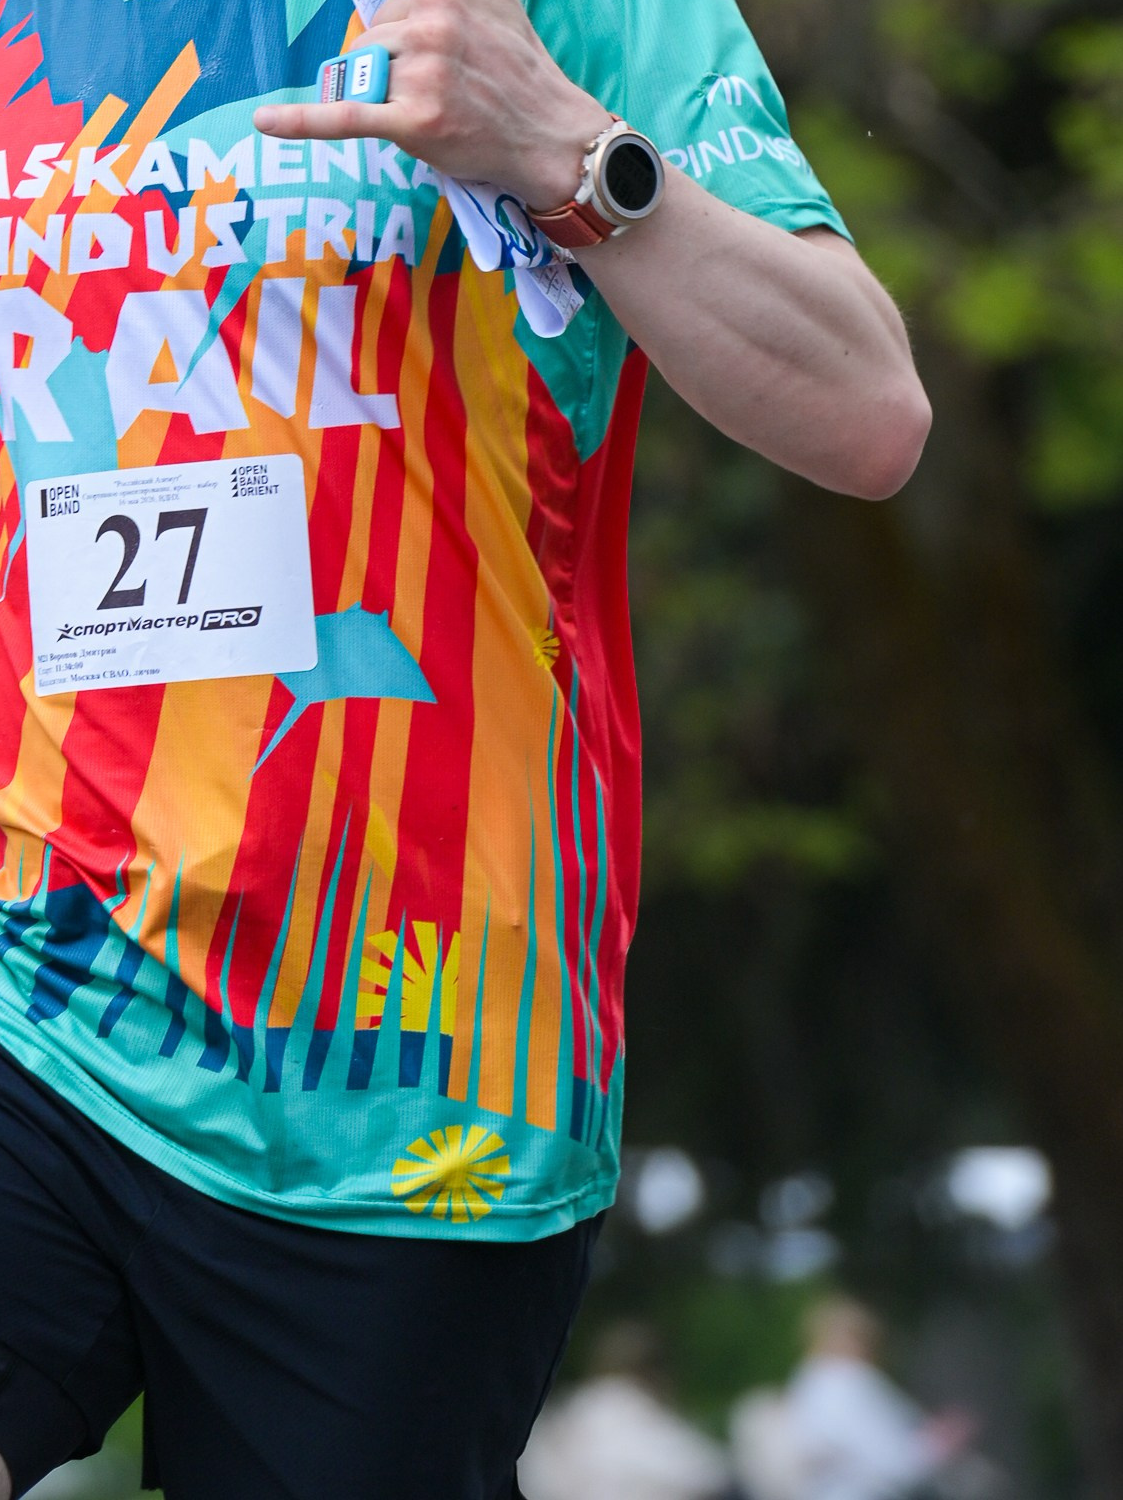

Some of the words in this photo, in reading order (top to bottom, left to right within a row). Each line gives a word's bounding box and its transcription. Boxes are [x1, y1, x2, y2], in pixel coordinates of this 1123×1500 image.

[358, 64, 368, 87] 140
[238, 464, 268, 476] OPEN
[239, 475, 269, 486] BAND
[49, 484, 80, 500] OPEN
[239, 484, 280, 497] ORIENT
[49, 501, 81, 518] BAND
[95, 507, 209, 611] 27
[203, 608, 259, 628] PRO
[79, 646, 117, 658] Дмитрий
[70, 673, 101, 682] Москва
